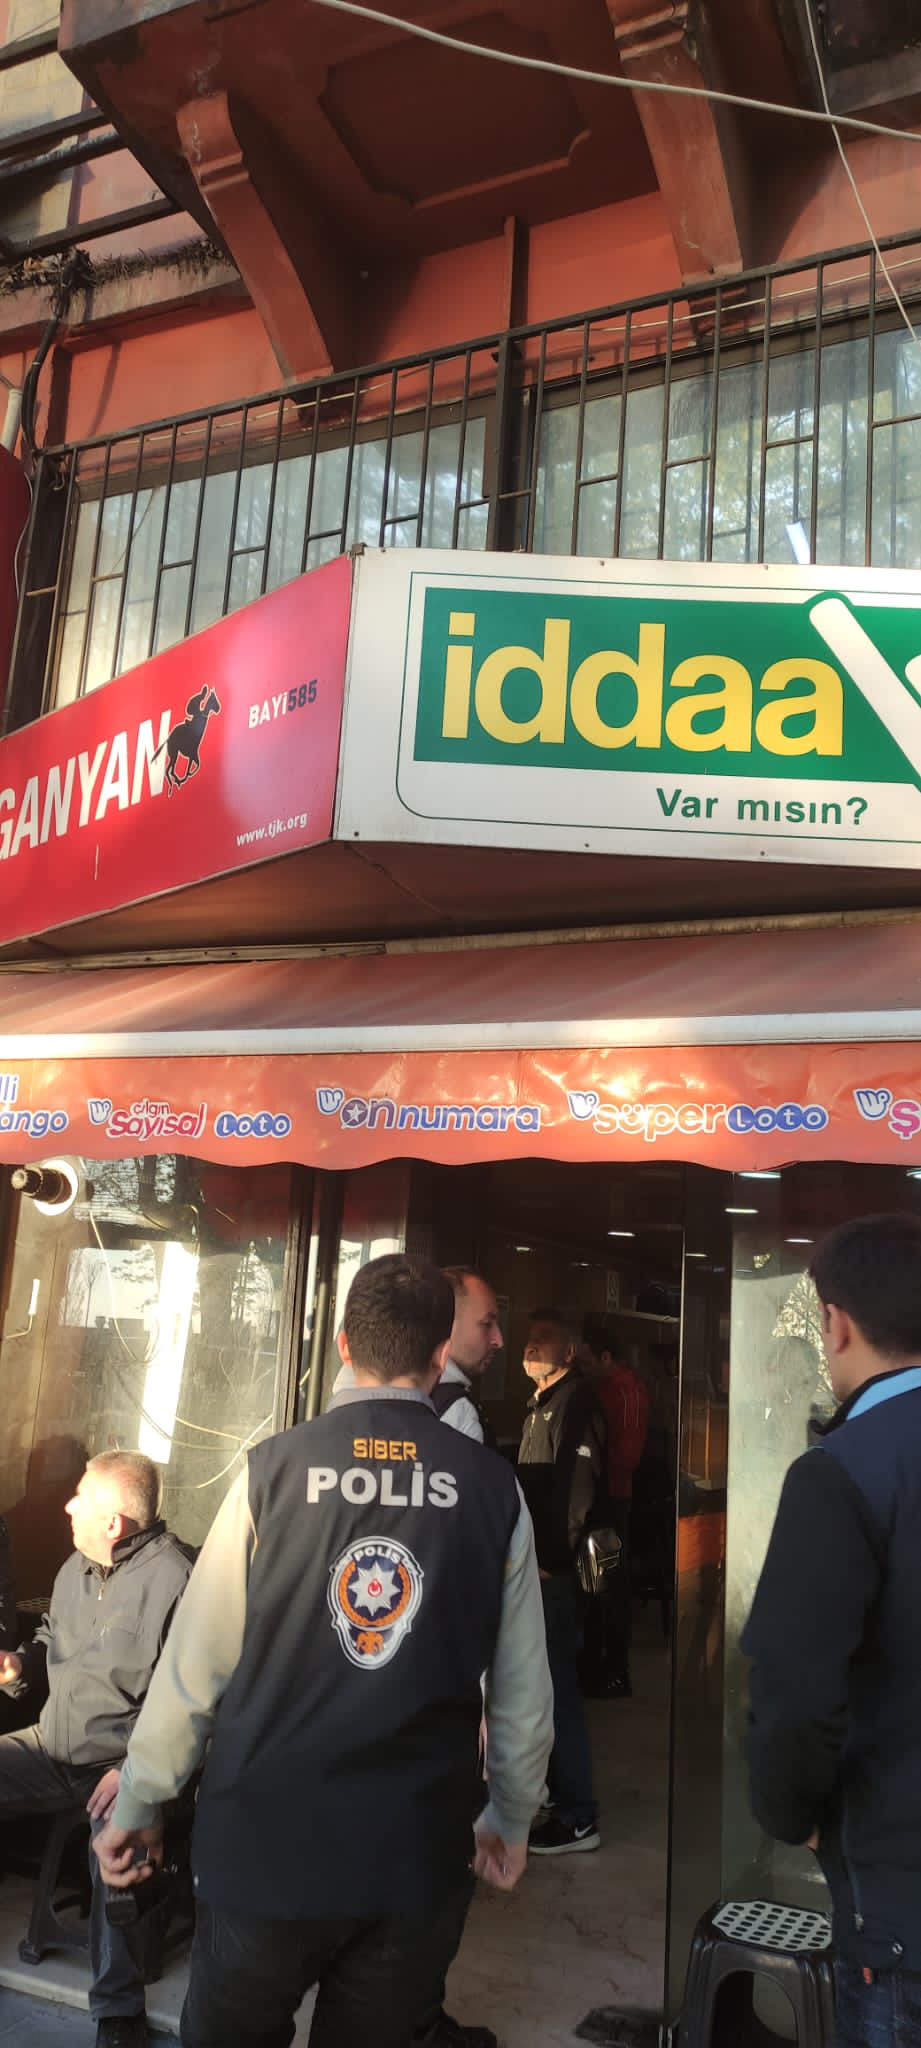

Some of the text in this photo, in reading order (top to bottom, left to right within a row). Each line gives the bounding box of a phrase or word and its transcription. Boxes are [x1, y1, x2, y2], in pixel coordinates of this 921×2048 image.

[441, 611, 843, 756] iddaa
[0, 709, 172, 860] GANYAN
[656, 787, 869, 825] Var mısın?
[236, 812, 309, 847] www.tjk.org
[0, 1111, 68, 1137] ango
[400, 1105, 540, 1132] numara
[594, 1103, 726, 1142] süper
[353, 1437, 417, 1461] SİBER
[306, 1462, 459, 1508] POLİS
[353, 1545, 402, 1565] POLİS
